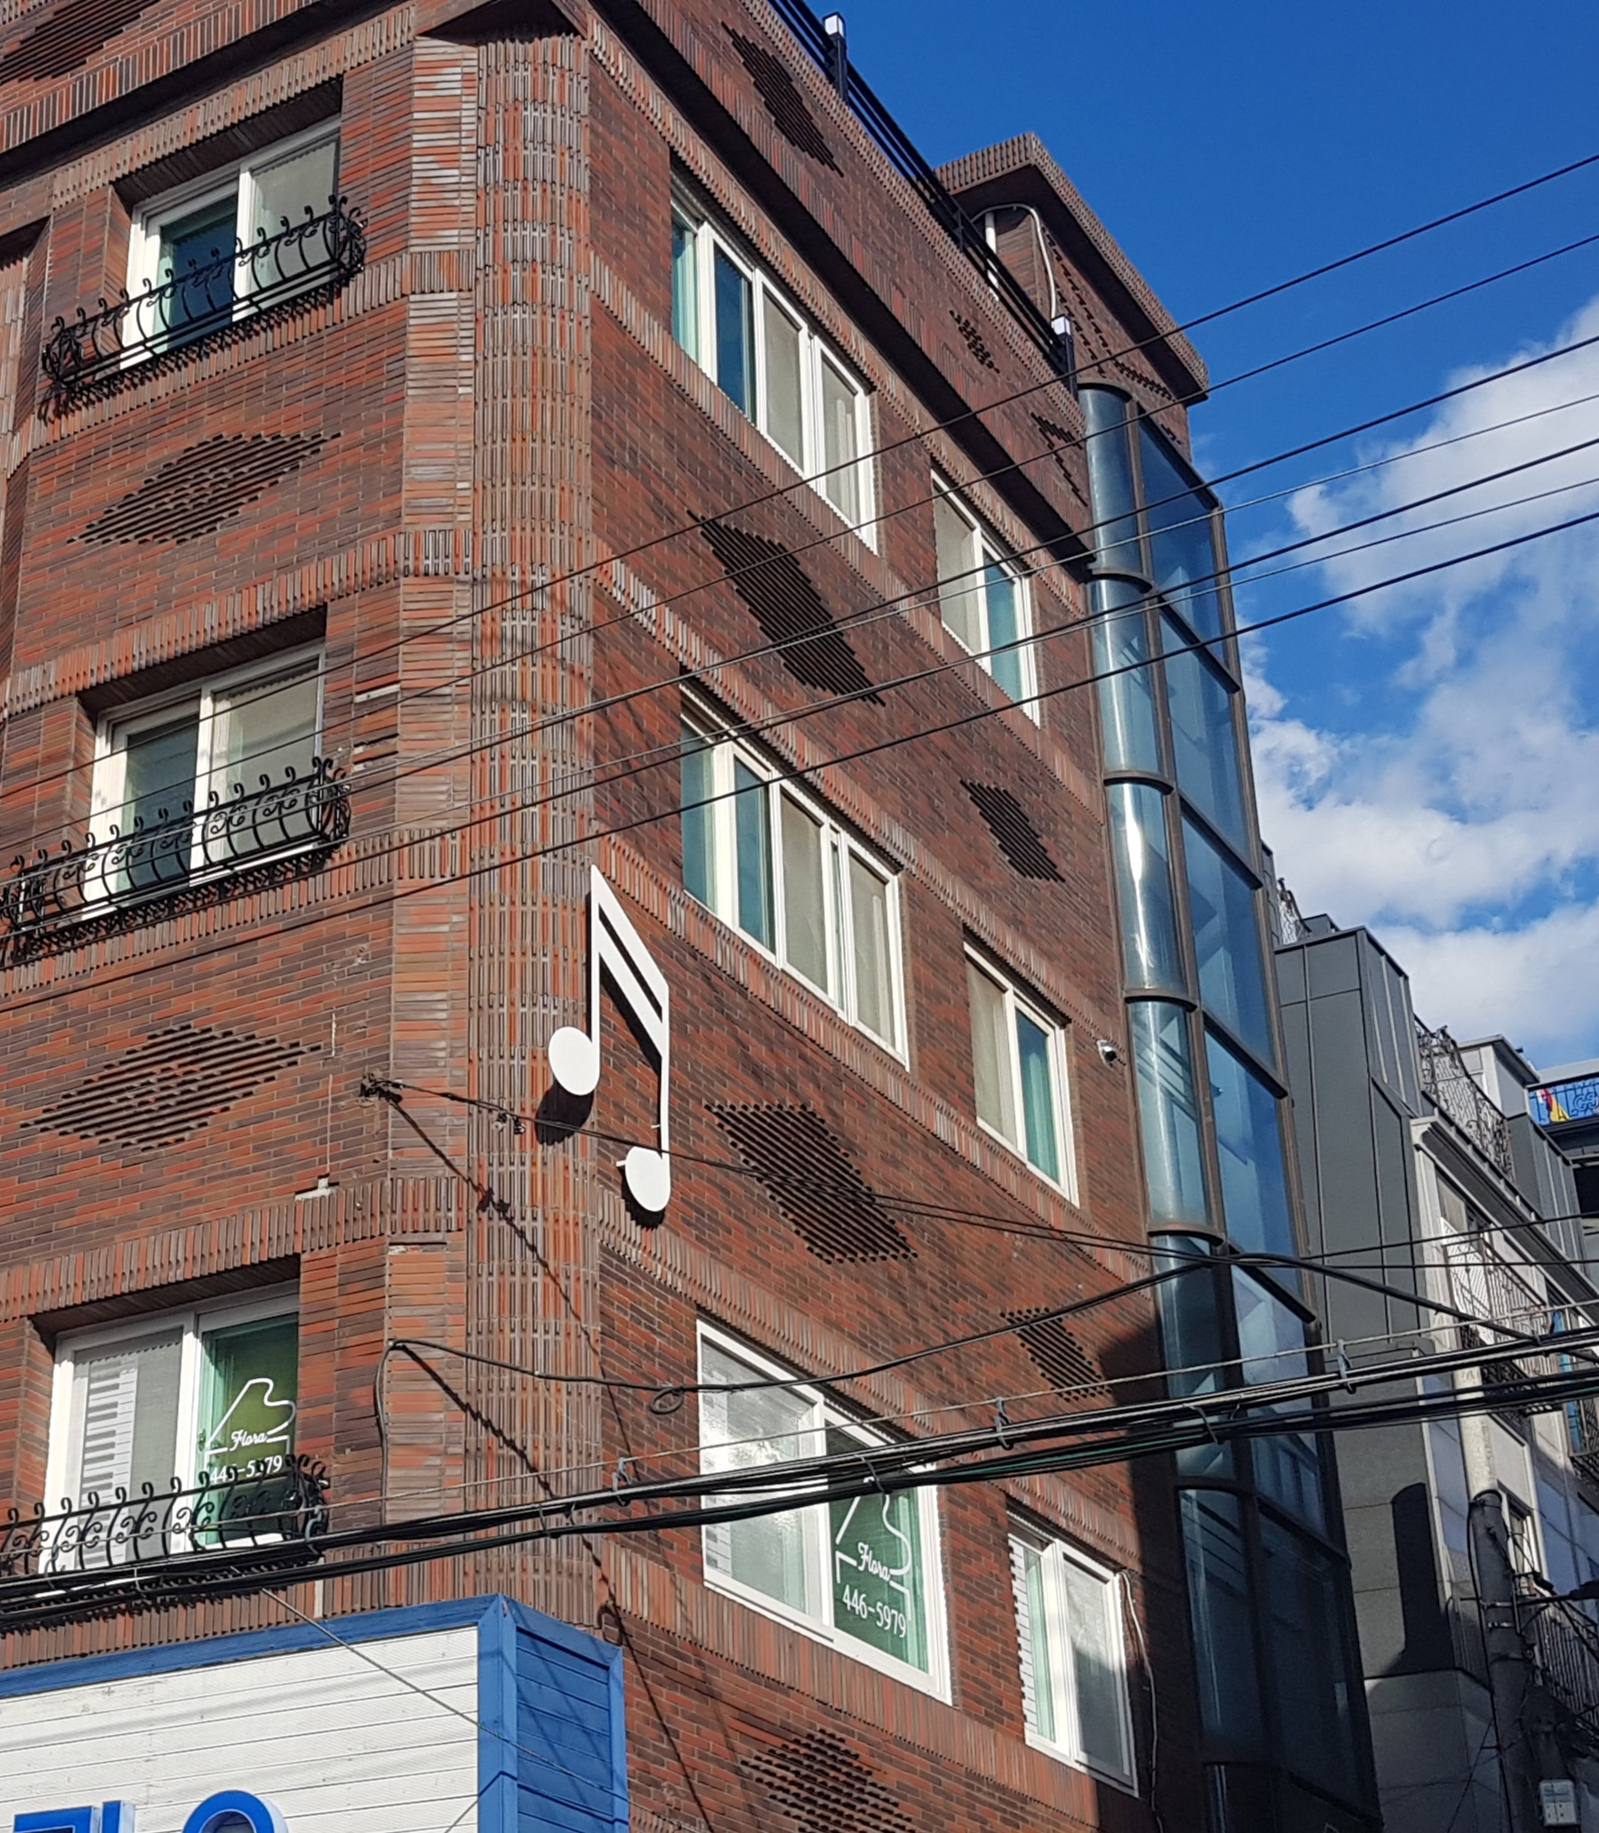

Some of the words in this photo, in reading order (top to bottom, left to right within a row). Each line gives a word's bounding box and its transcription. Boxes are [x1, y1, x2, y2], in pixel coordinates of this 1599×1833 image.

[229, 1429, 268, 1452] Flora
[857, 1542, 891, 1581] Flora
[842, 1584, 907, 1638] 446-5979
